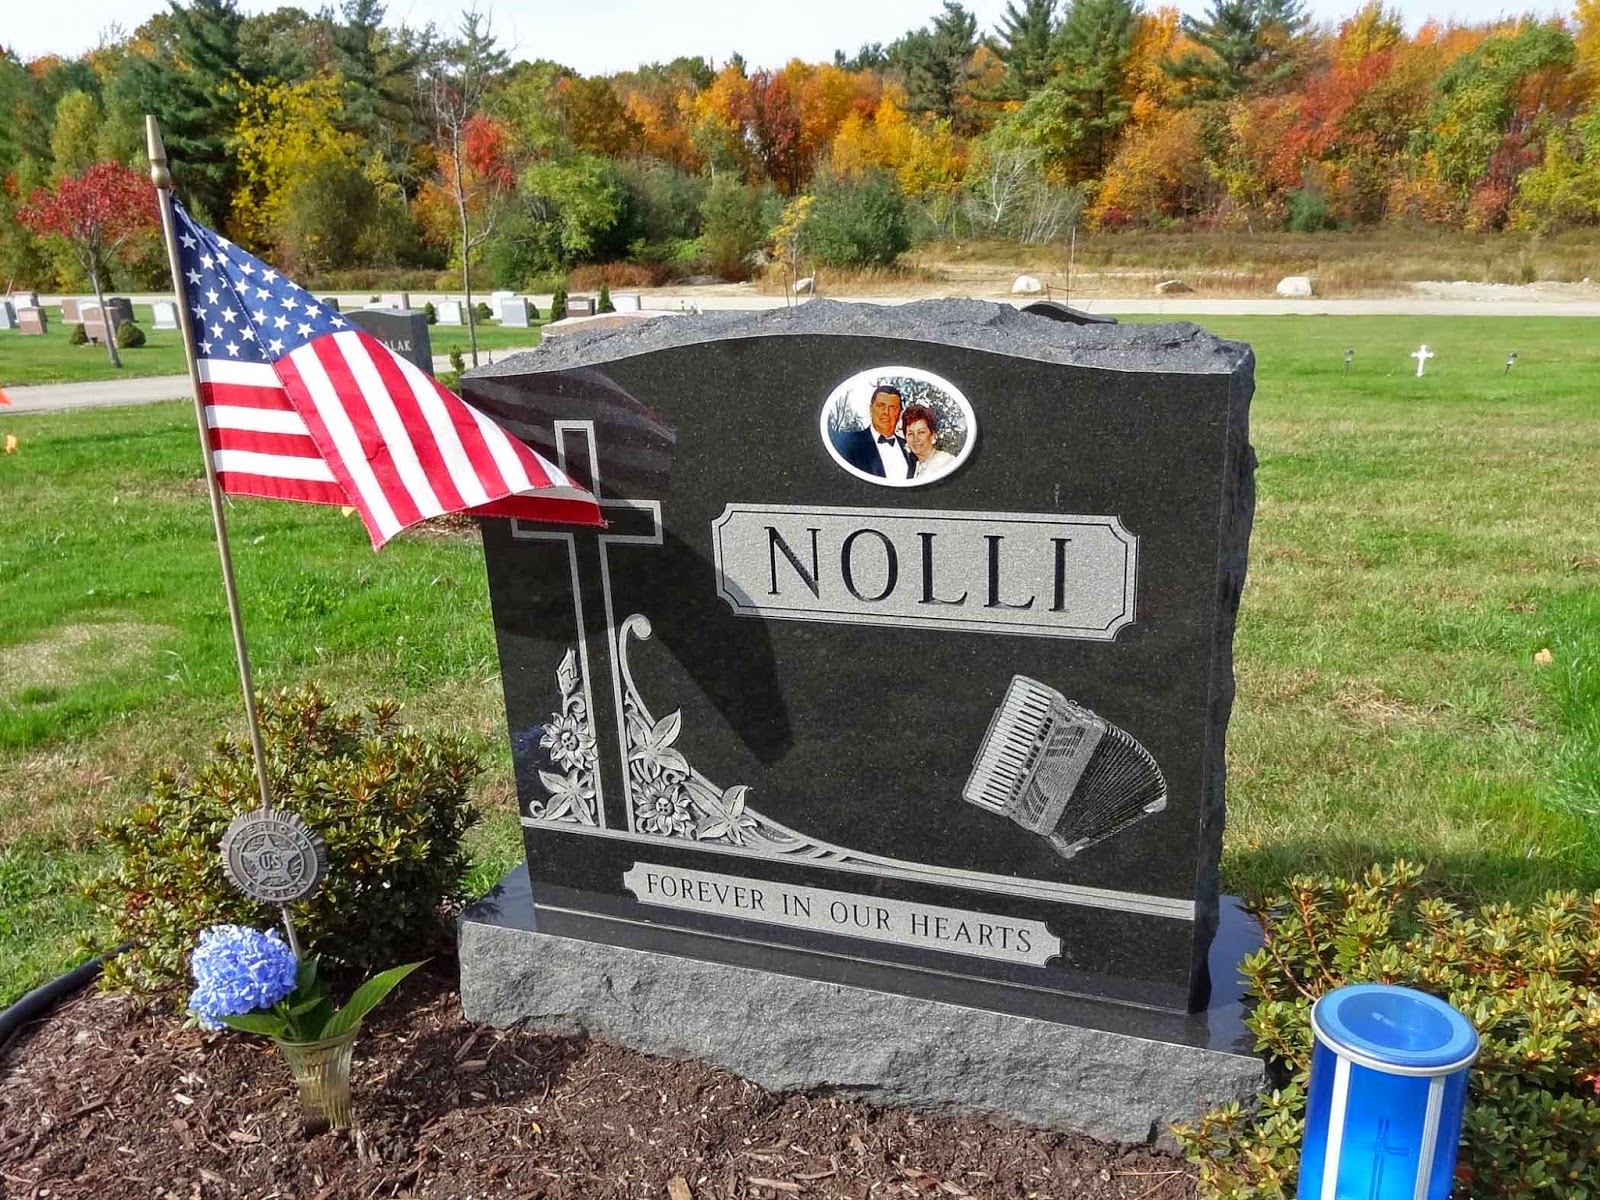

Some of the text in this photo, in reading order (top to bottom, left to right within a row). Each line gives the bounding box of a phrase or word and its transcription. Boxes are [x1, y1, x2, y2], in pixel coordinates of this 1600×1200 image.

[764, 526, 1072, 612] NOLLI
[231, 821, 309, 853] AMERICAN
[260, 853, 283, 870] US
[646, 873, 1032, 954] FOREVER IN OUR HEARTS
